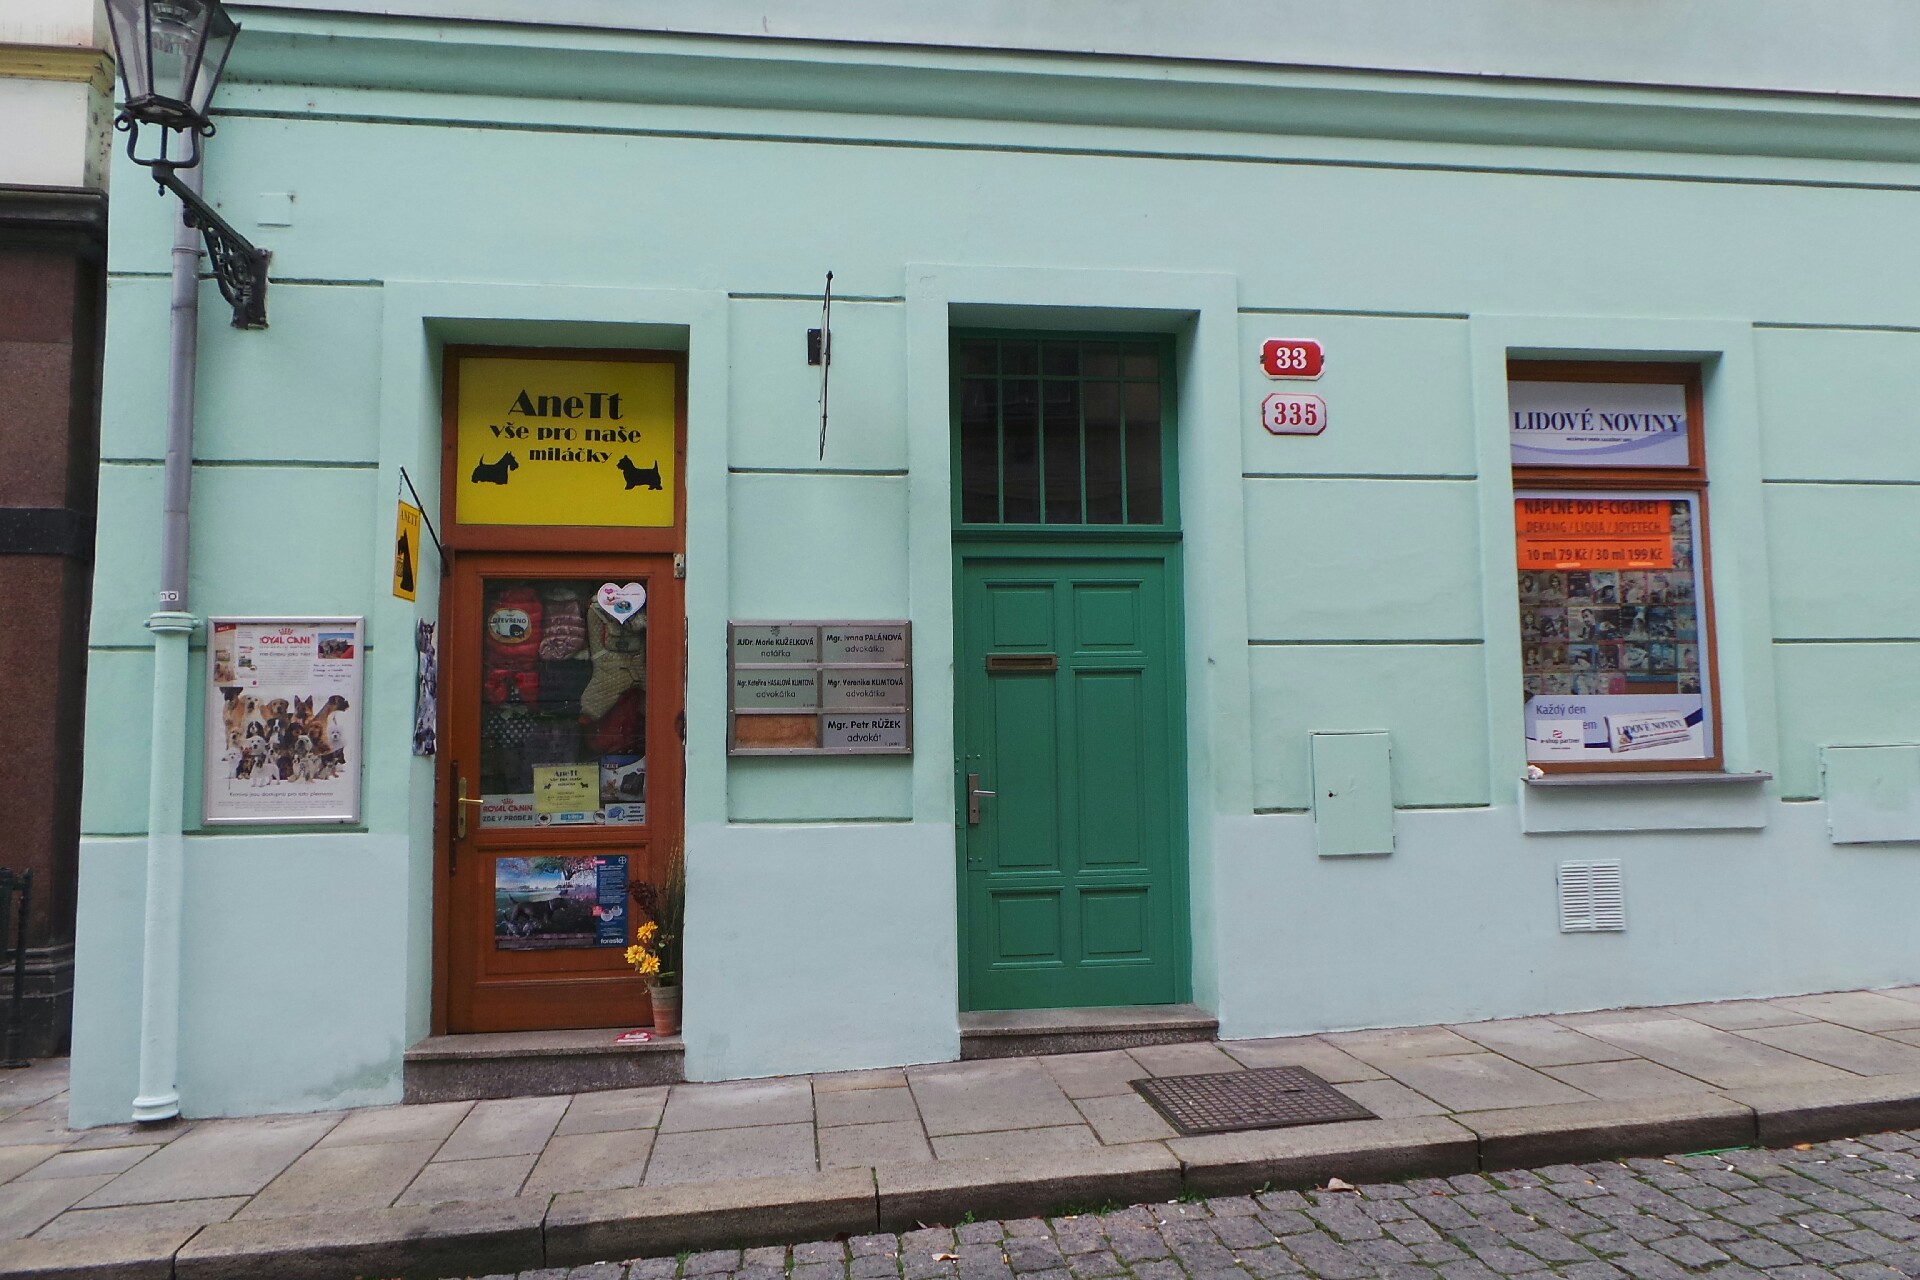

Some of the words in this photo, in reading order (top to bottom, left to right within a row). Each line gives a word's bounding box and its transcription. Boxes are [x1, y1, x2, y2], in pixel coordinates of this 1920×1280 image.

[1276, 347, 1307, 369] 33
[507, 389, 623, 420] AneTt
[1274, 402, 1317, 426] 335
[1514, 408, 1594, 431] LIDOVÉ
[1599, 413, 1681, 432] NOVINY
[490, 422, 529, 439] vše
[537, 427, 577, 441] pro
[585, 426, 641, 443] naše
[529, 447, 613, 463] miláčky
[1527, 549, 1540, 560] 10
[1543, 548, 1557, 560] ml
[1560, 549, 1572, 560] 79
[1575, 548, 1588, 560] Kč
[1596, 549, 1609, 560] 30
[1612, 548, 1625, 560] ml
[1628, 549, 1649, 560] 199
[1650, 548, 1663, 560] Kč
[737, 639, 754, 647] JUDr.
[755, 638, 774, 646] Marie
[775, 636, 814, 646] KUŽELKOVÁ
[826, 634, 842, 643] Mgr.
[865, 633, 902, 641] PALÁNOVÁ
[761, 649, 791, 657] notářka
[845, 644, 885, 653] advokátka
[827, 679, 842, 688] Mgr.
[871, 677, 903, 686] KLIMTOVÁ
[756, 689, 796, 698] advokátka
[845, 689, 885, 697] advokátka
[1536, 703, 1565, 716] Každý
[1568, 704, 1586, 714] den
[827, 720, 848, 731] Mgr.
[851, 720, 869, 729] Petr
[871, 717, 901, 729] RŮŽEK
[1651, 719, 1682, 730] NOVINY
[847, 733, 881, 742] advokát
[508, 804, 533, 812] CANIN
